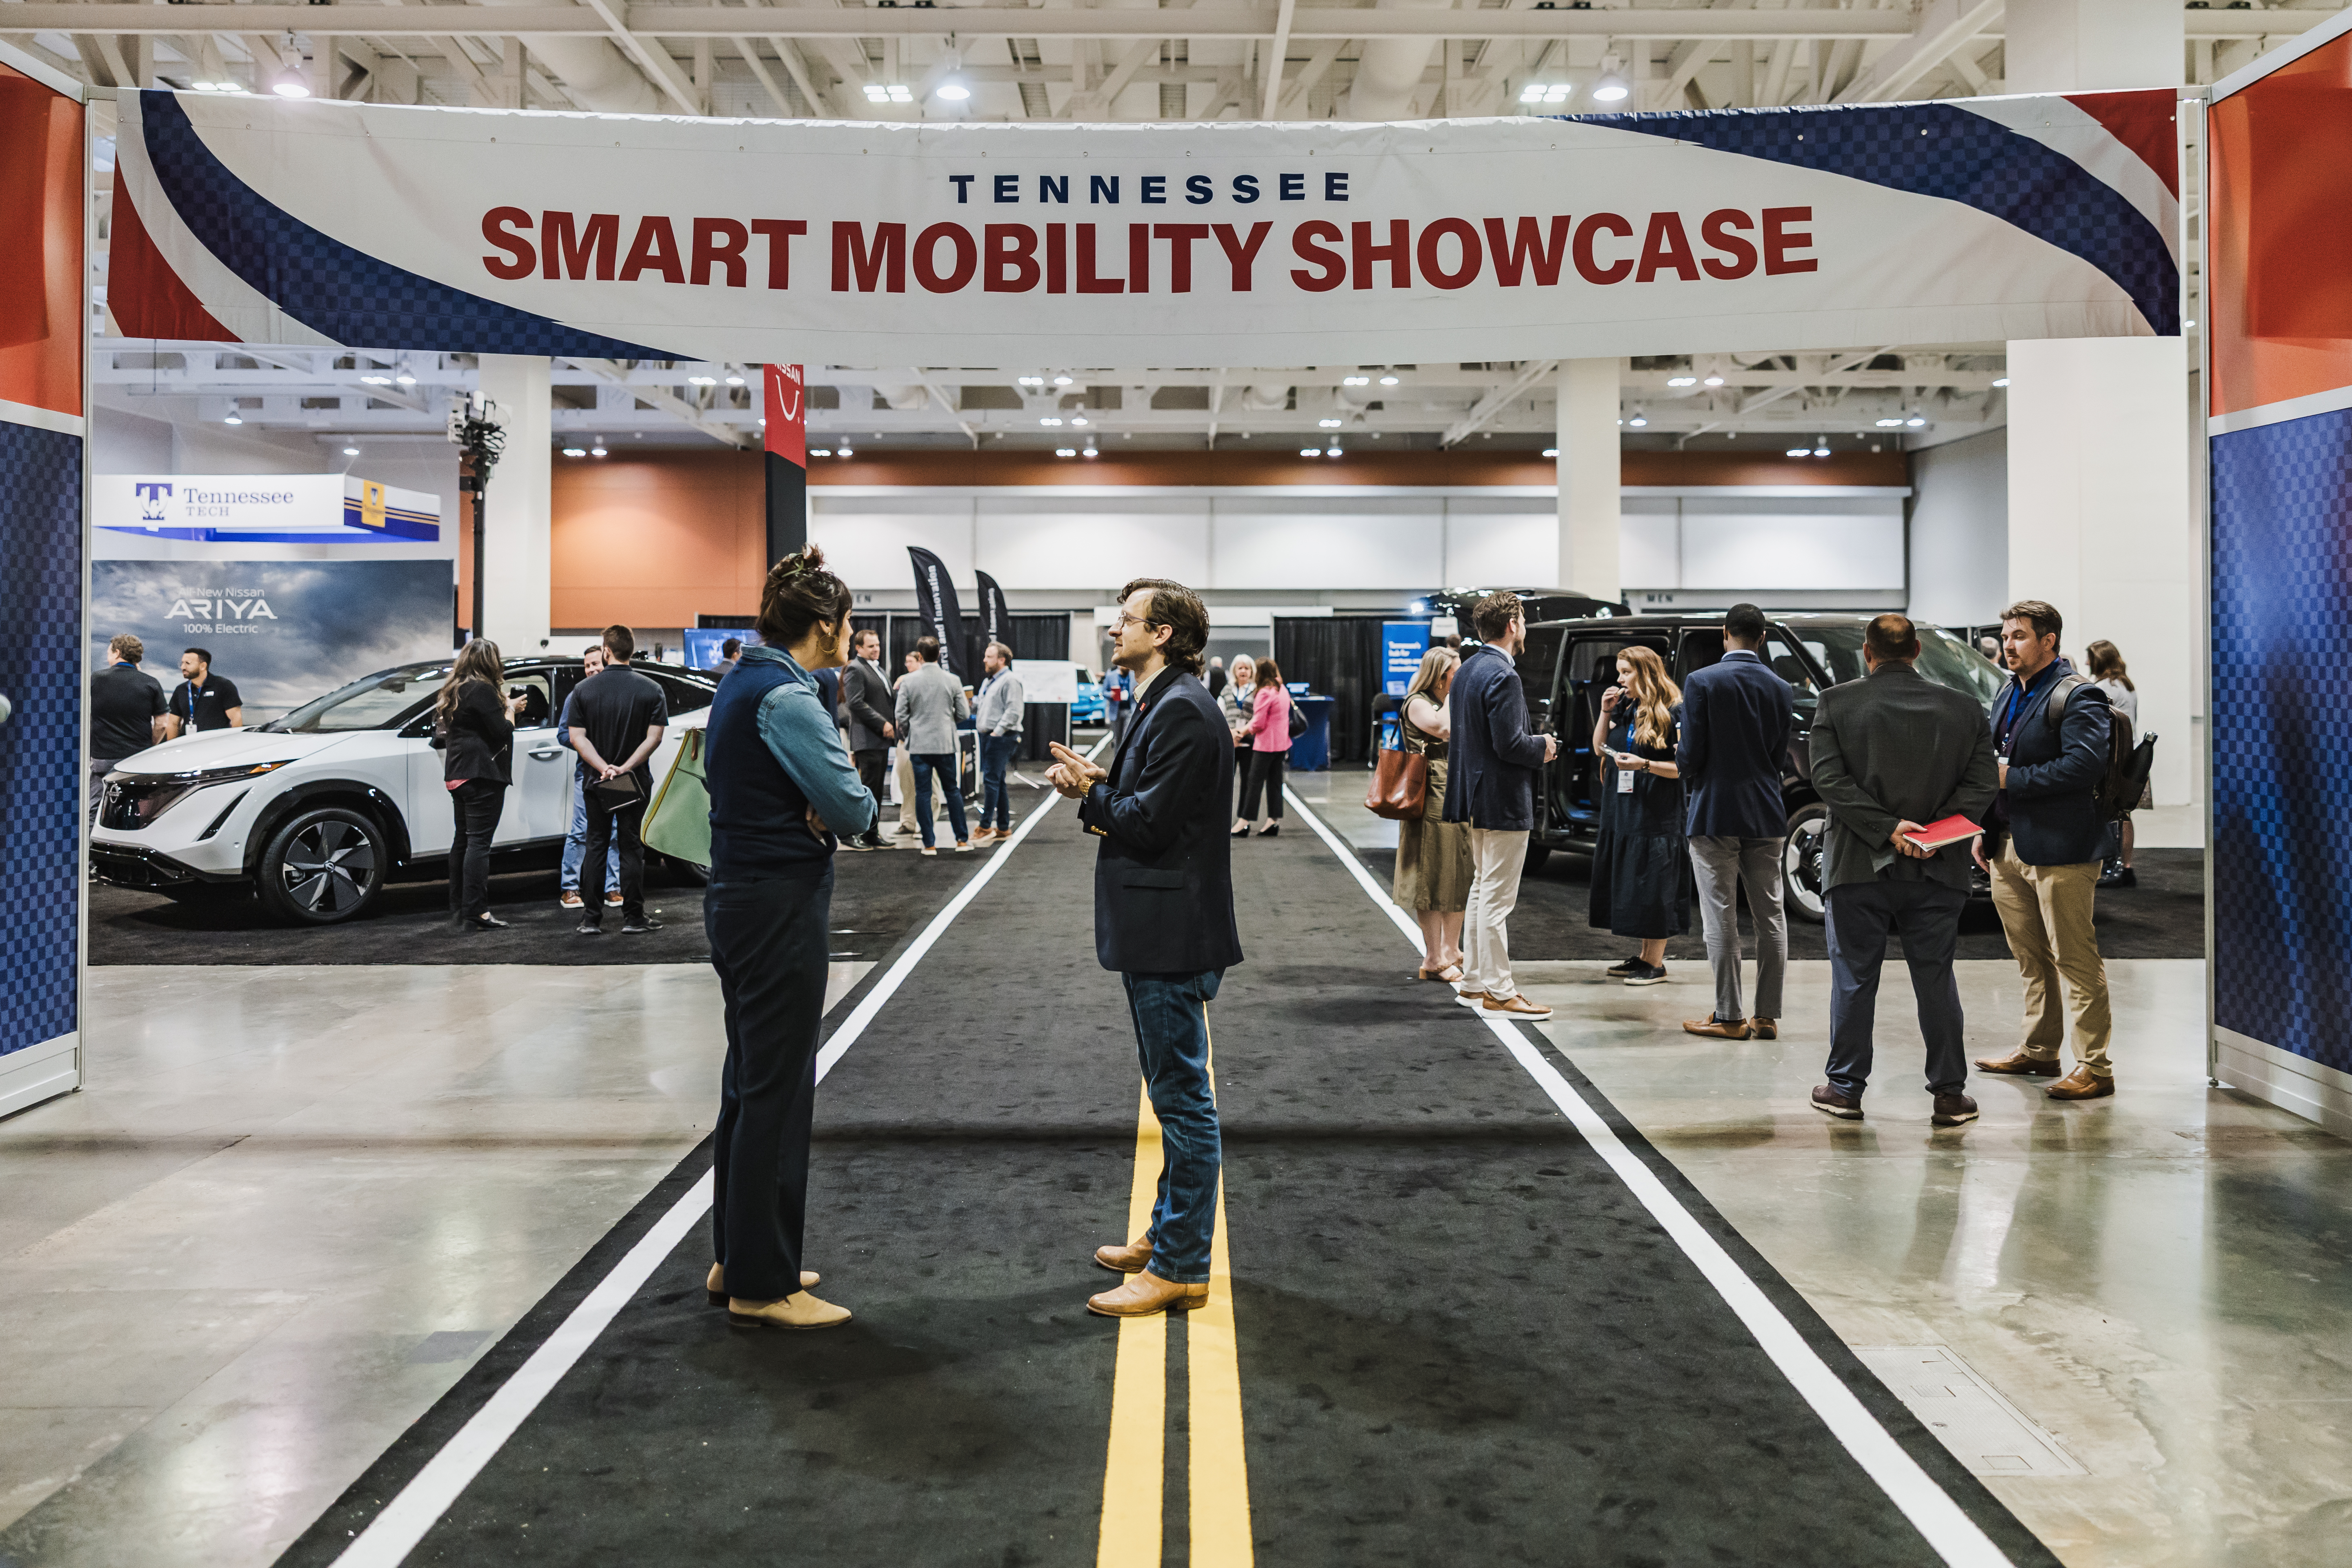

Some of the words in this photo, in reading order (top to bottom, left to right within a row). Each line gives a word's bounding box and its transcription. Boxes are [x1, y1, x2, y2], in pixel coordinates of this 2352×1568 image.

[949, 172, 1349, 205] TENNESSEE
[482, 206, 807, 290] SMART
[831, 221, 1273, 294] MOBILITY
[1291, 206, 1817, 291] SHOWCASE
[184, 488, 293, 504] Tennessee
[186, 506, 230, 517] TECH
[179, 587, 223, 597] All-New
[226, 587, 265, 597] Nissan
[851, 594, 871, 603] EN
[927, 565, 944, 622] Innovation
[164, 598, 278, 620] ARIYA
[183, 623, 213, 634] 100%
[215, 623, 259, 634] Electric
[934, 624, 947, 645] and
[939, 645, 950, 673] arch
